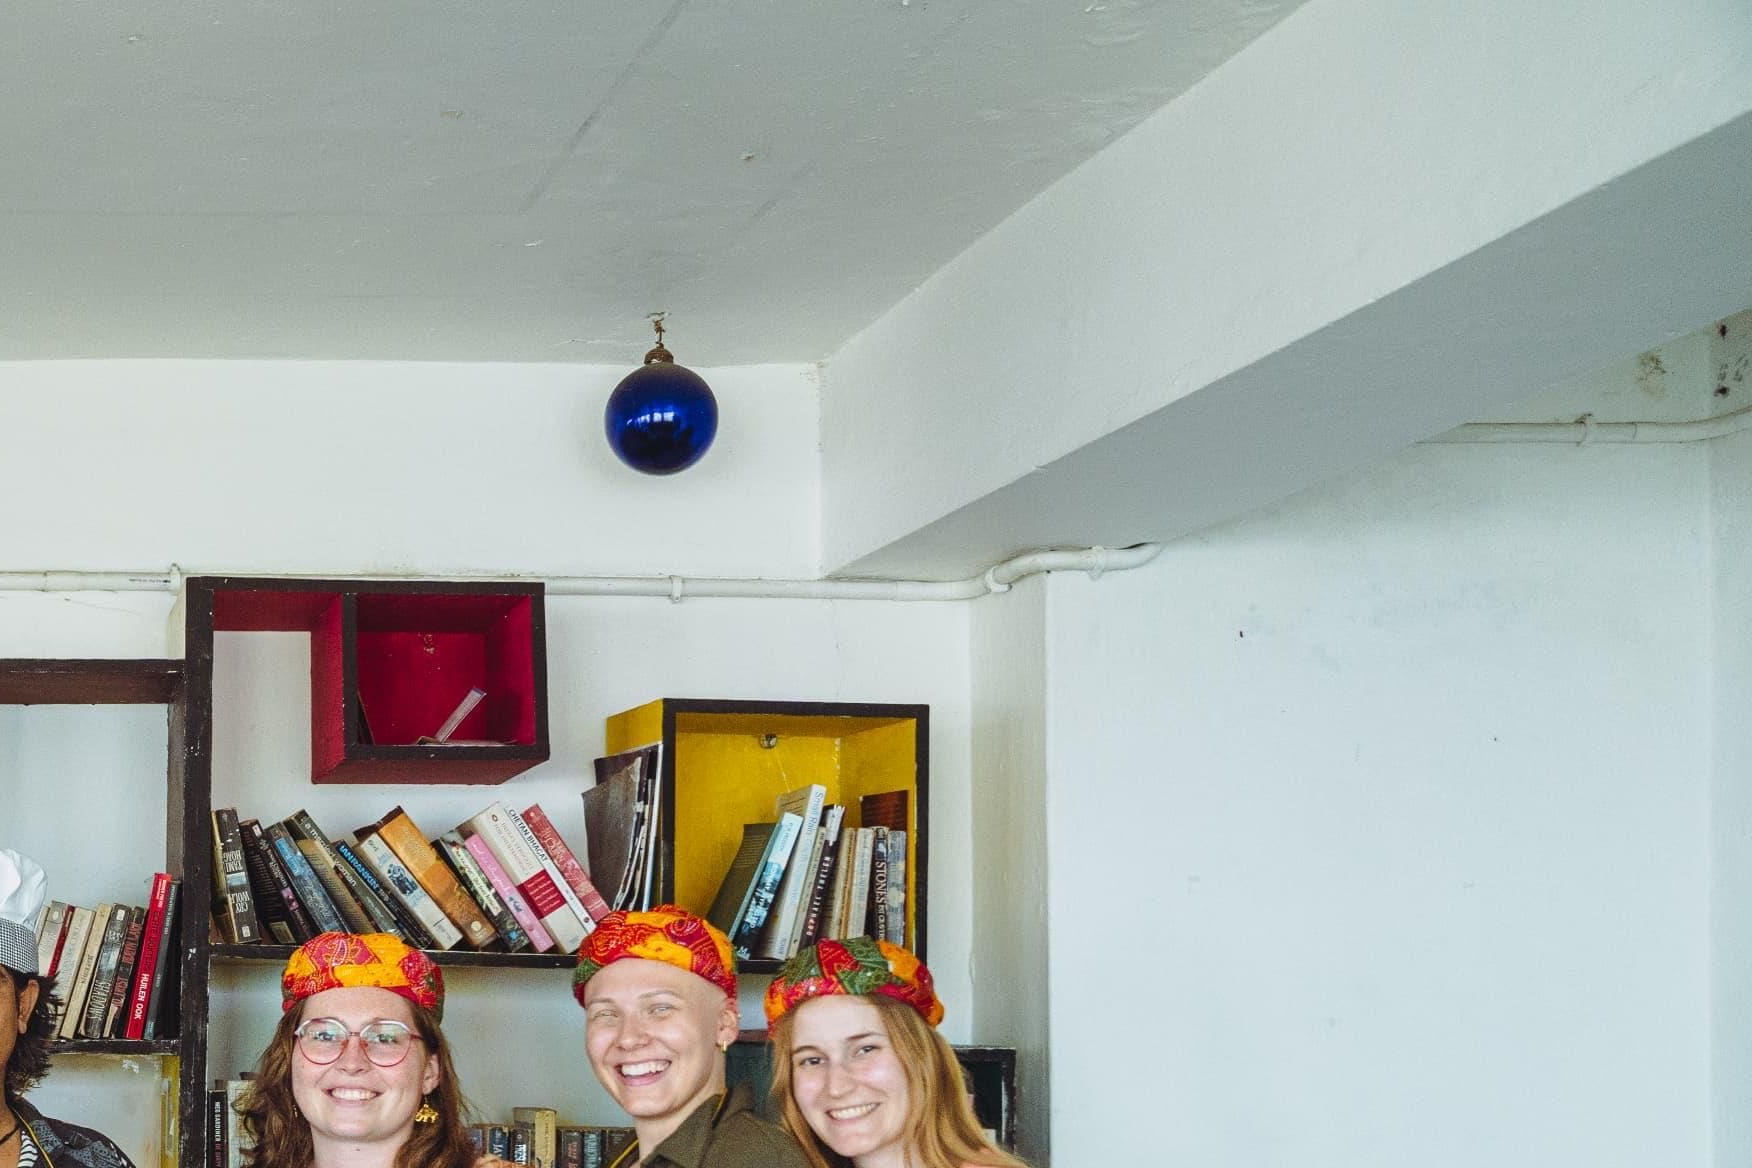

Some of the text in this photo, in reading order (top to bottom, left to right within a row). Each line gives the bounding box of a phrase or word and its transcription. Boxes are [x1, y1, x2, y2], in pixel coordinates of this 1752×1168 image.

[506, 808, 549, 863] CHETAN BHAGAT
[223, 850, 241, 863] HOAG
[226, 861, 243, 873] TAMI
[332, 858, 357, 888] woman
[338, 844, 355, 862] IAN
[349, 857, 380, 890] RANKIN
[231, 891, 249, 904] WOLF
[875, 861, 886, 903] STONES
[236, 901, 248, 913] CRY
[85, 979, 111, 1021] SHADOWS
[133, 973, 149, 1020] HUILEN OOK
